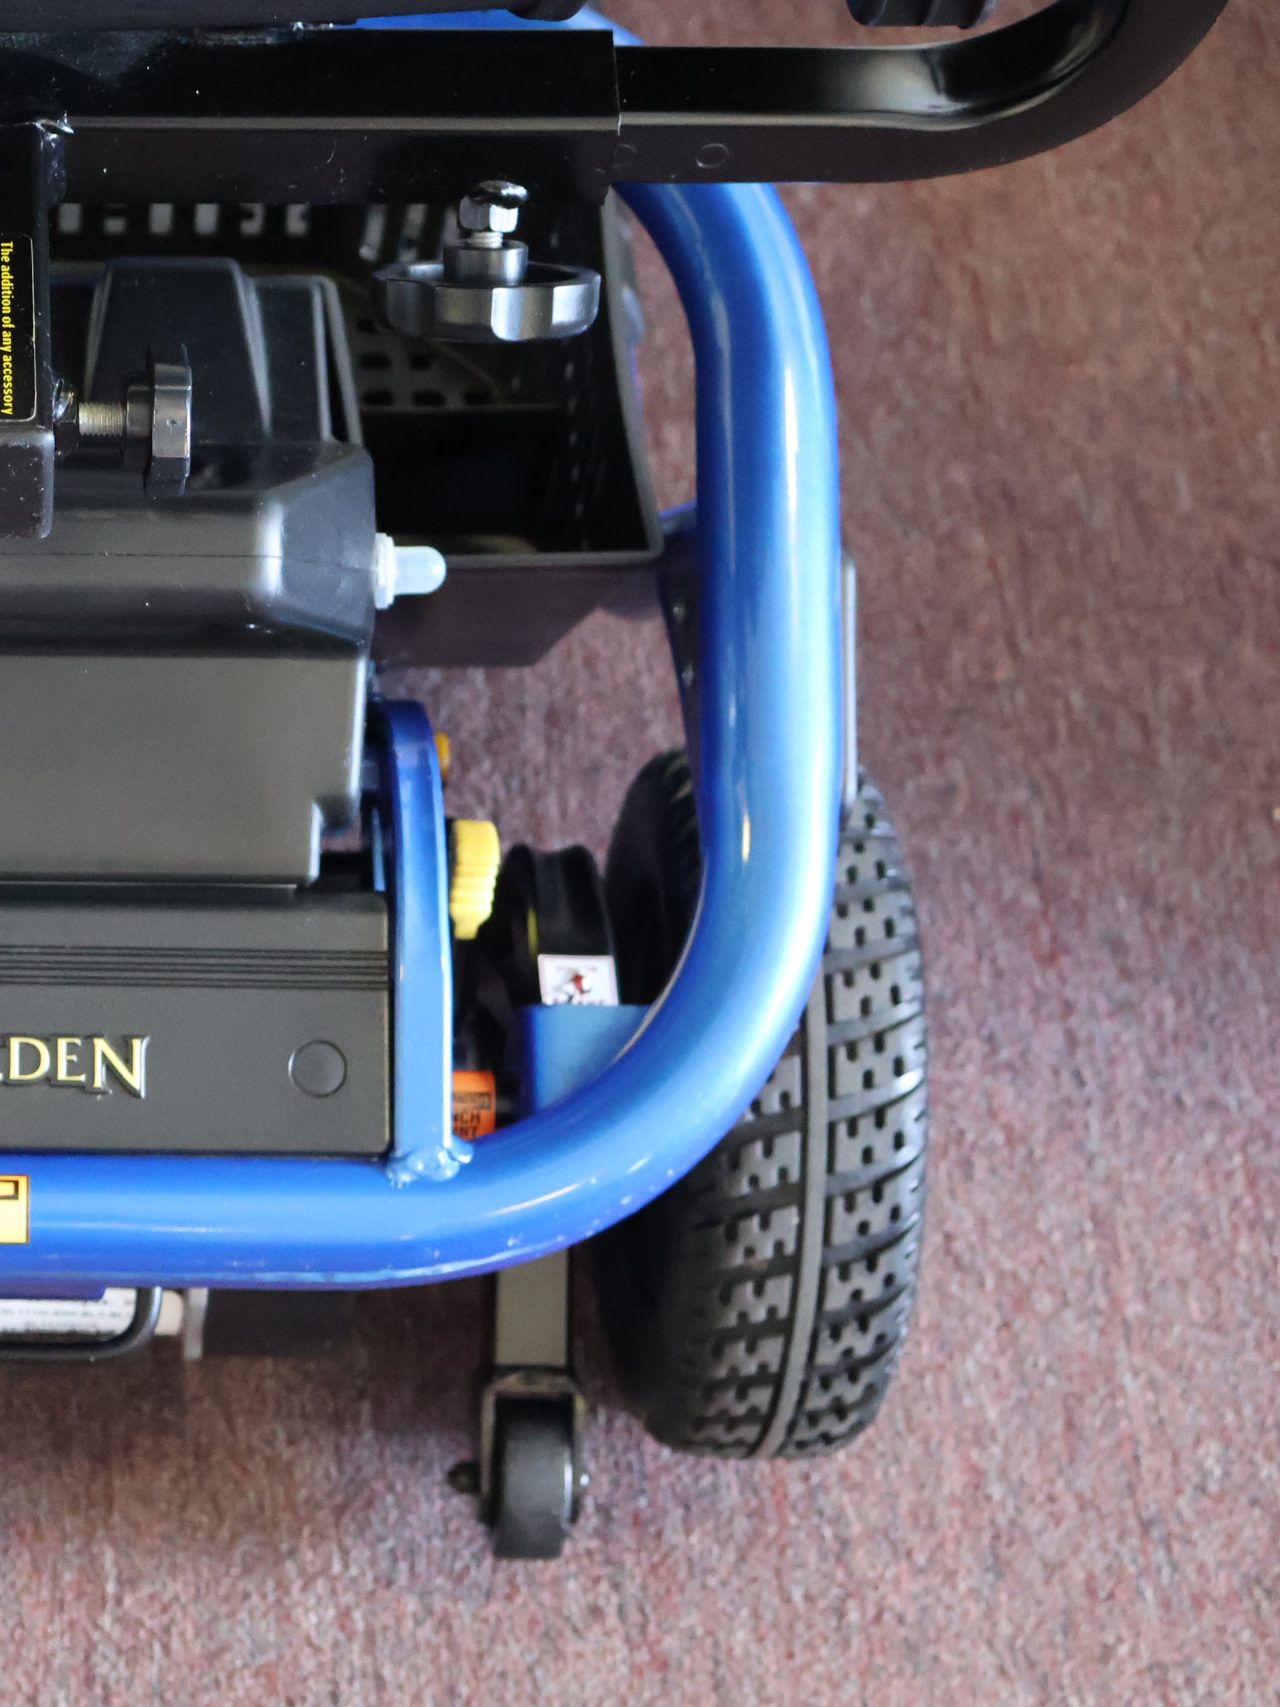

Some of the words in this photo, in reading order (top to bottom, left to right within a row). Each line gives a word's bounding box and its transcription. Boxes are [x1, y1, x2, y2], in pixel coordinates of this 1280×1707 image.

[0, 241, 14, 263] The
[1, 264, 15, 314] addition
[1, 316, 15, 329] of
[0, 331, 12, 353] any
[0, 354, 14, 415] accessory
